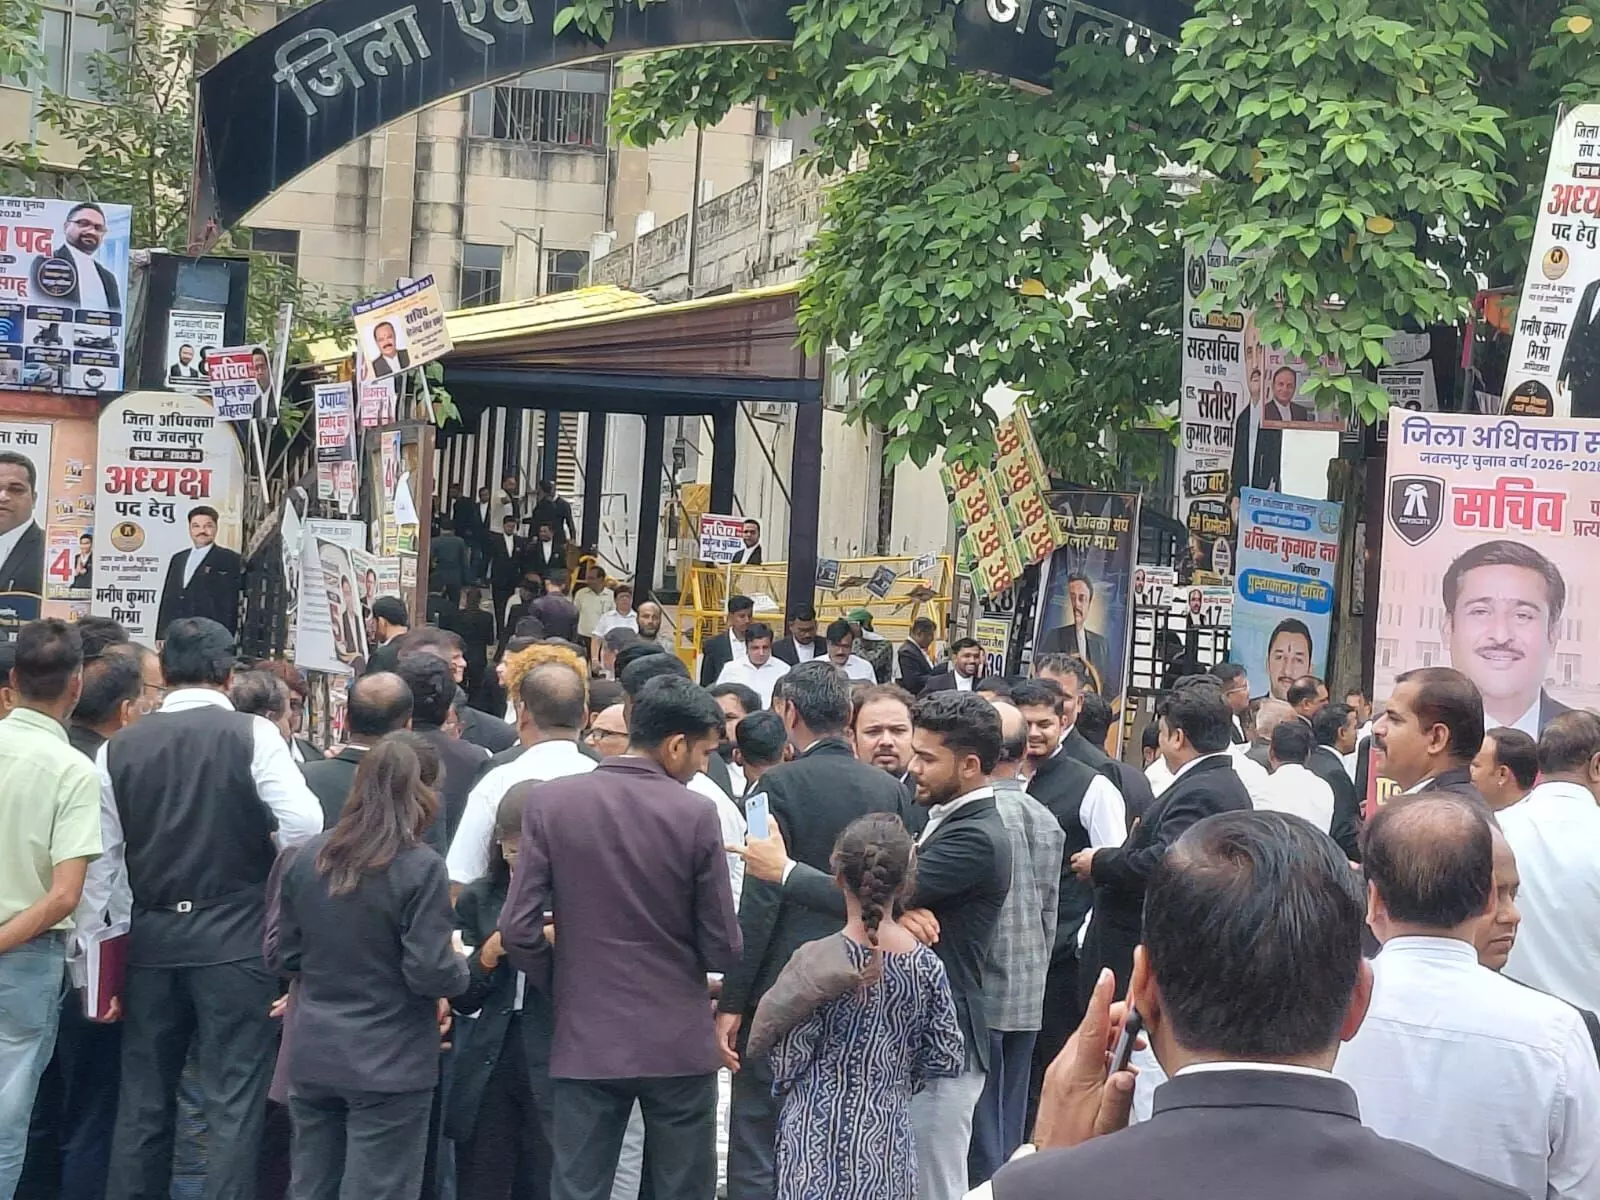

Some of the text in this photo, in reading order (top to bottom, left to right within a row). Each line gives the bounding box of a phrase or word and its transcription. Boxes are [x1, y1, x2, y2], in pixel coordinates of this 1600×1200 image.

[272, 4, 431, 116] जिला
[1574, 121, 1599, 139] जिला
[14, 226, 54, 257] पद
[1552, 220, 1599, 249] पद हेतु
[1543, 321, 1567, 343] कुमार
[1187, 334, 1239, 363] सहसचिव
[1527, 341, 1550, 361] मिश्रा
[210, 357, 249, 380] सचिव
[1198, 381, 1237, 425] सतीश
[123, 409, 215, 428] जिला अधिवक्ता
[157, 431, 204, 448] जबलपुर
[997, 420, 1020, 456] 38
[1186, 422, 1211, 449] कुमार
[1402, 416, 1466, 446] जिला
[1472, 420, 1579, 453] अधिवक्ता
[1009, 456, 1032, 491] 38
[1420, 453, 1469, 470] जबलपुर
[1472, 456, 1506, 471] चुनाव
[1510, 454, 1530, 469] वर्ष
[105, 466, 213, 500] अध्यक्ष
[115, 498, 176, 524] पद हेतु
[967, 488, 990, 523] 38
[1021, 491, 1044, 526] 38
[1452, 477, 1567, 532] सचिव
[703, 521, 737, 537] सचिव
[978, 522, 1000, 557] 38
[1031, 523, 1054, 560] 38
[1244, 526, 1279, 554] रविन्द्र
[1281, 537, 1317, 562] कुमार
[50, 548, 73, 582] 4
[989, 556, 1012, 592] 38
[97, 584, 157, 609] मनीष कुमार
[1148, 585, 1164, 606] 17
[111, 606, 141, 624] मिश्रा
[1206, 606, 1222, 625] 17
